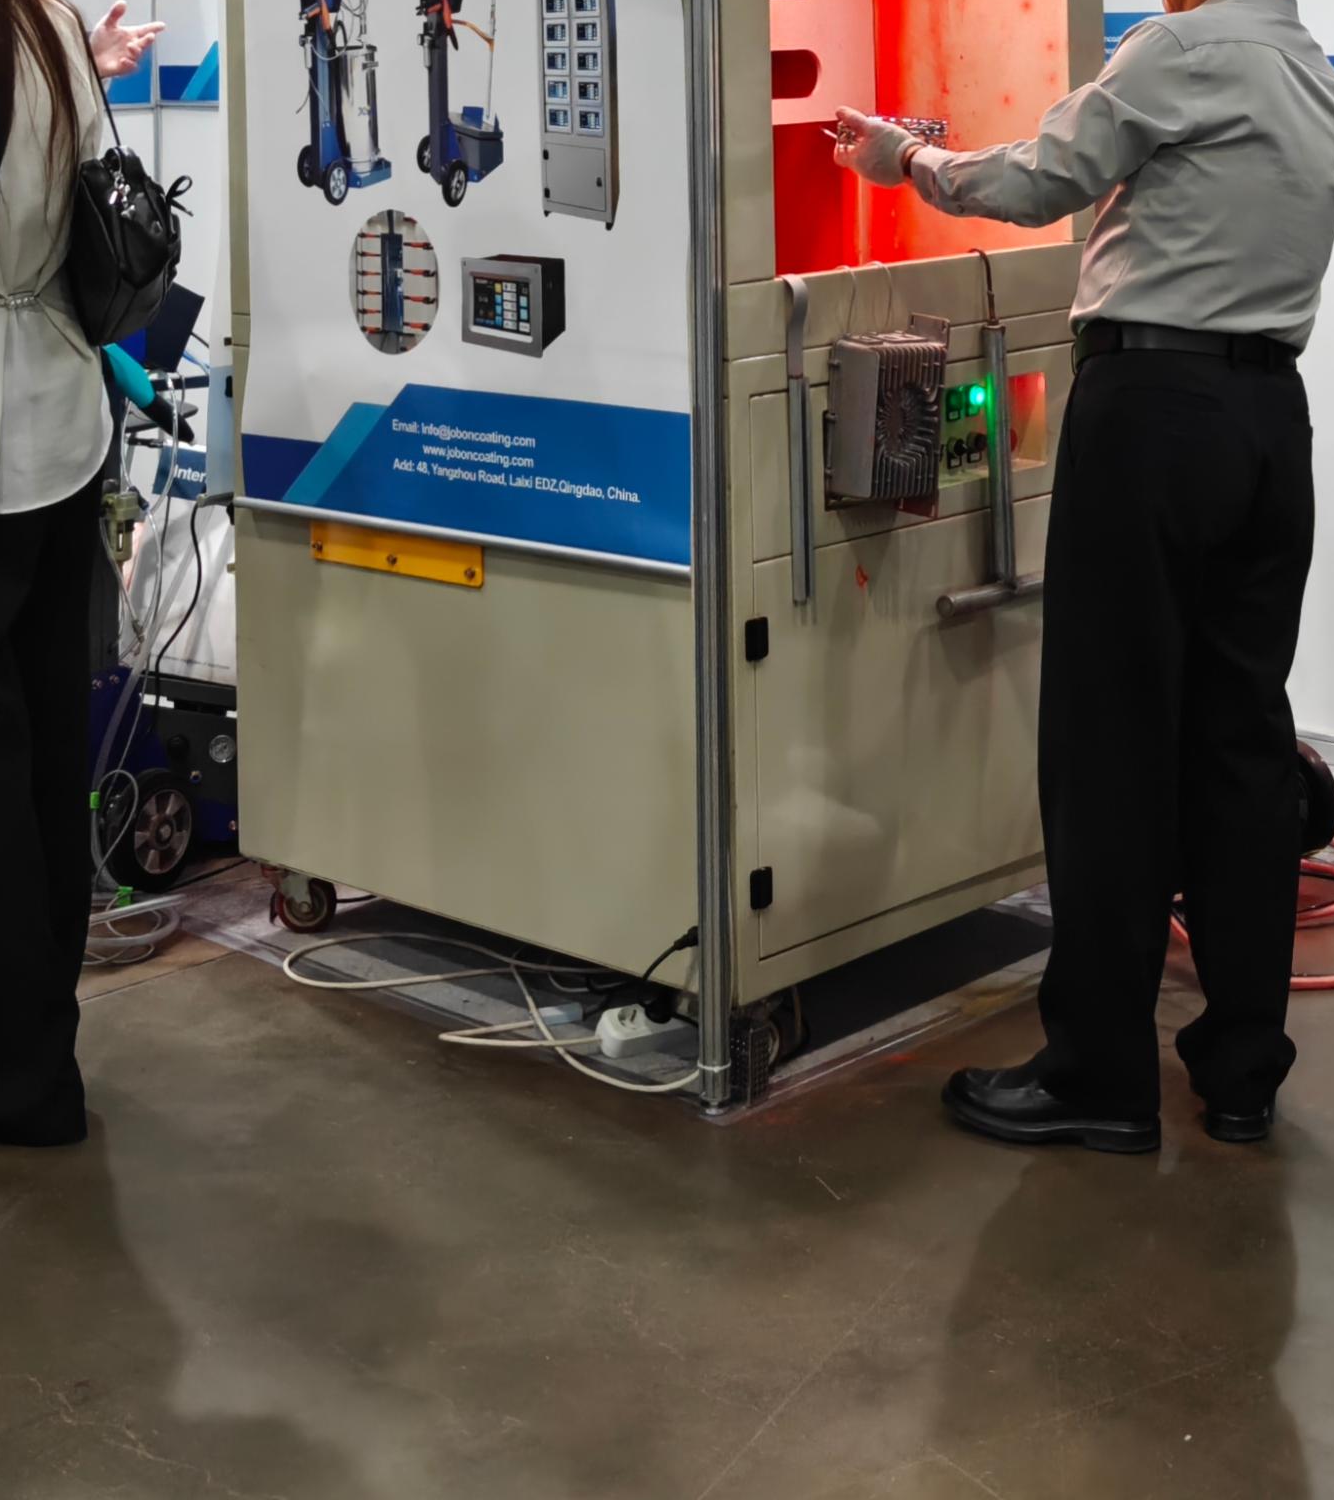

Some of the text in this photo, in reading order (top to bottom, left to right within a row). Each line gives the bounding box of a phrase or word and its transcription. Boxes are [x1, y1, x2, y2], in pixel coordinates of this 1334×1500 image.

[392, 418, 536, 449] Email: Info@joboncoating.com
[422, 443, 535, 469] www.joboncoating.com
[393, 457, 415, 473] Add:
[416, 460, 430, 476] 48,
[431, 462, 477, 483] Yangzhou
[477, 470, 507, 487] Road,
[606, 486, 641, 504] China.
